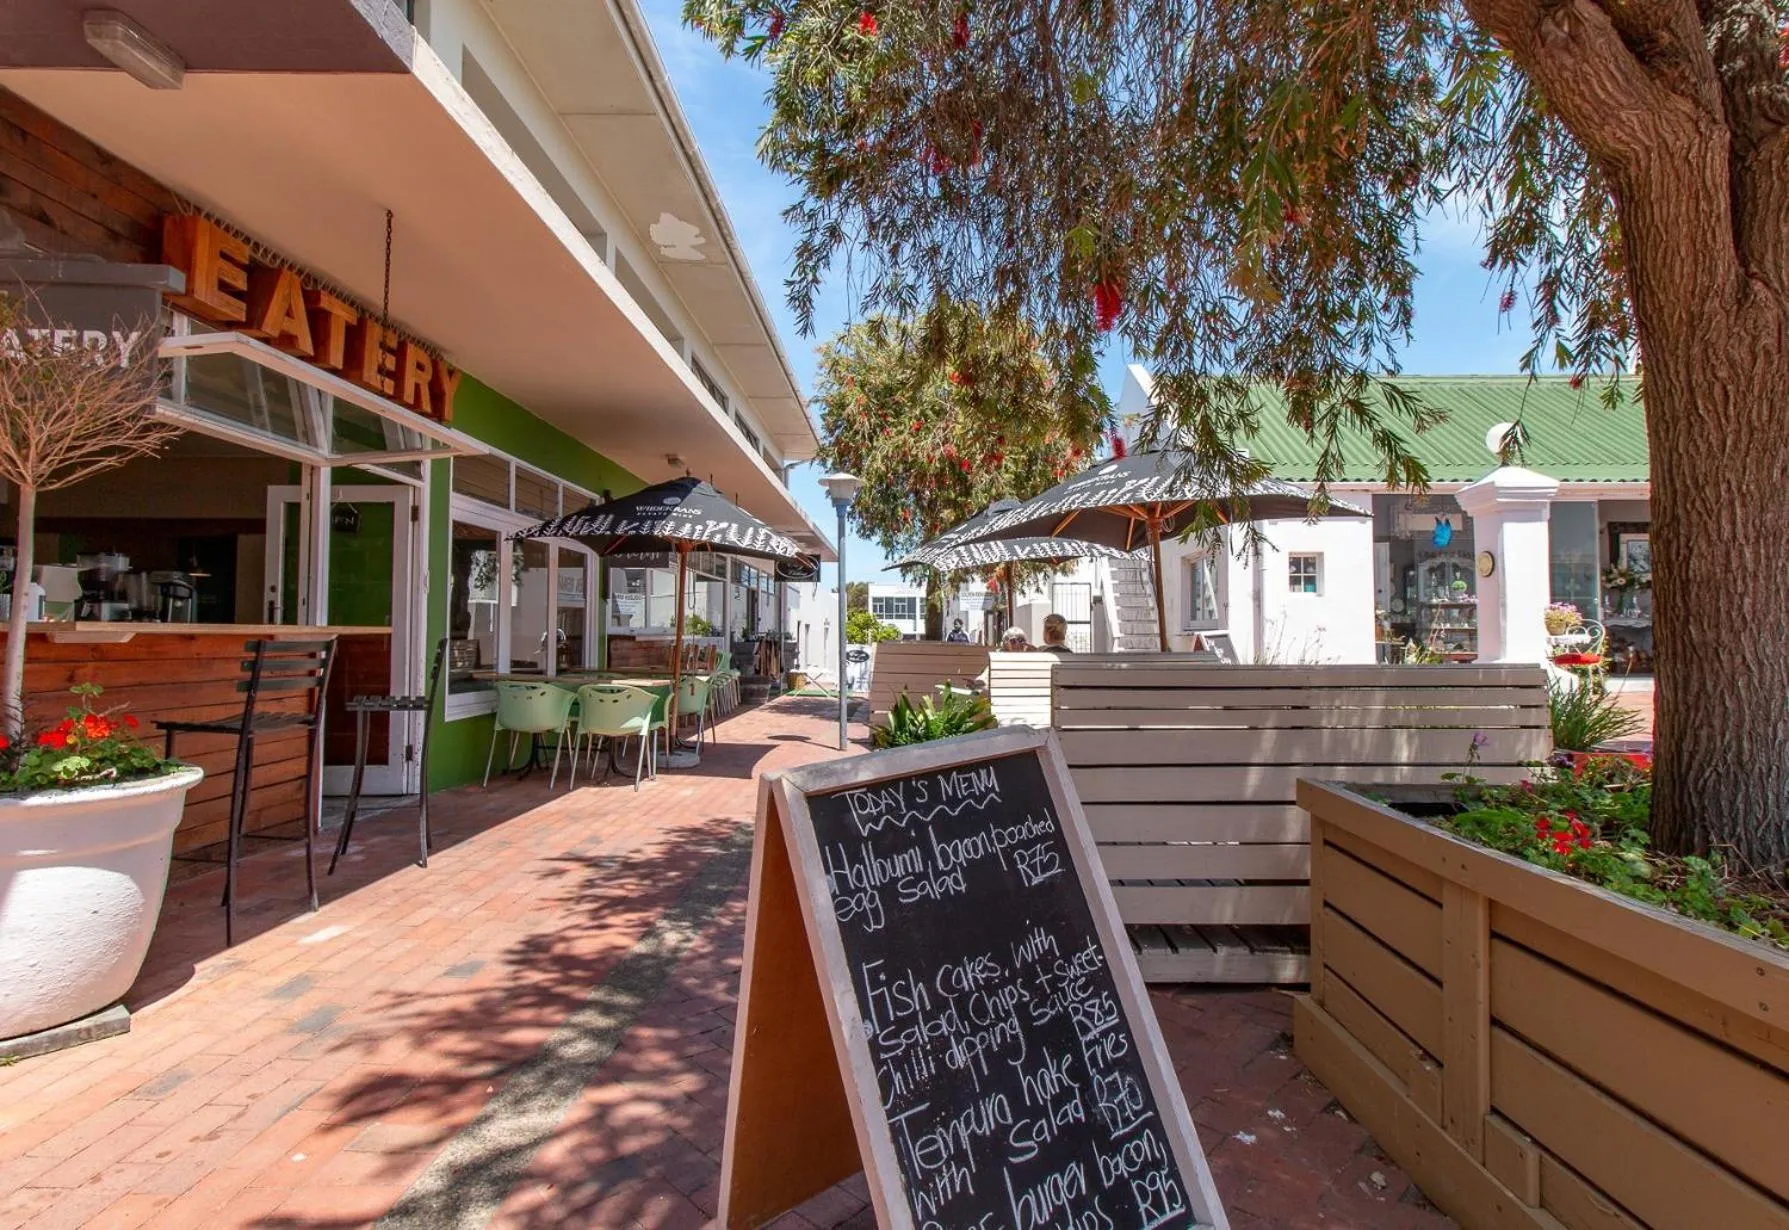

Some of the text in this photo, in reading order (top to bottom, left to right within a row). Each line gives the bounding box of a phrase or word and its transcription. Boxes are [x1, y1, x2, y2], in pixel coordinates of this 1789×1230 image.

[163, 215, 460, 424] EATERY
[832, 766, 1000, 830] TODAY'S MENU
[990, 808, 1055, 871] poached
[834, 889, 886, 932] egg
[1013, 840, 1066, 888] R75
[862, 959, 932, 1034] Fish
[1010, 926, 1060, 969] with
[1034, 963, 1053, 994] +
[945, 1012, 1027, 1092] dipping
[1068, 991, 1120, 1041] R85
[888, 1092, 1014, 1179] Tempura
[1016, 1047, 1081, 1106] hake
[911, 1160, 975, 1222] with
[1093, 1069, 1154, 1140] R70
[1131, 1164, 1186, 1230] R95
